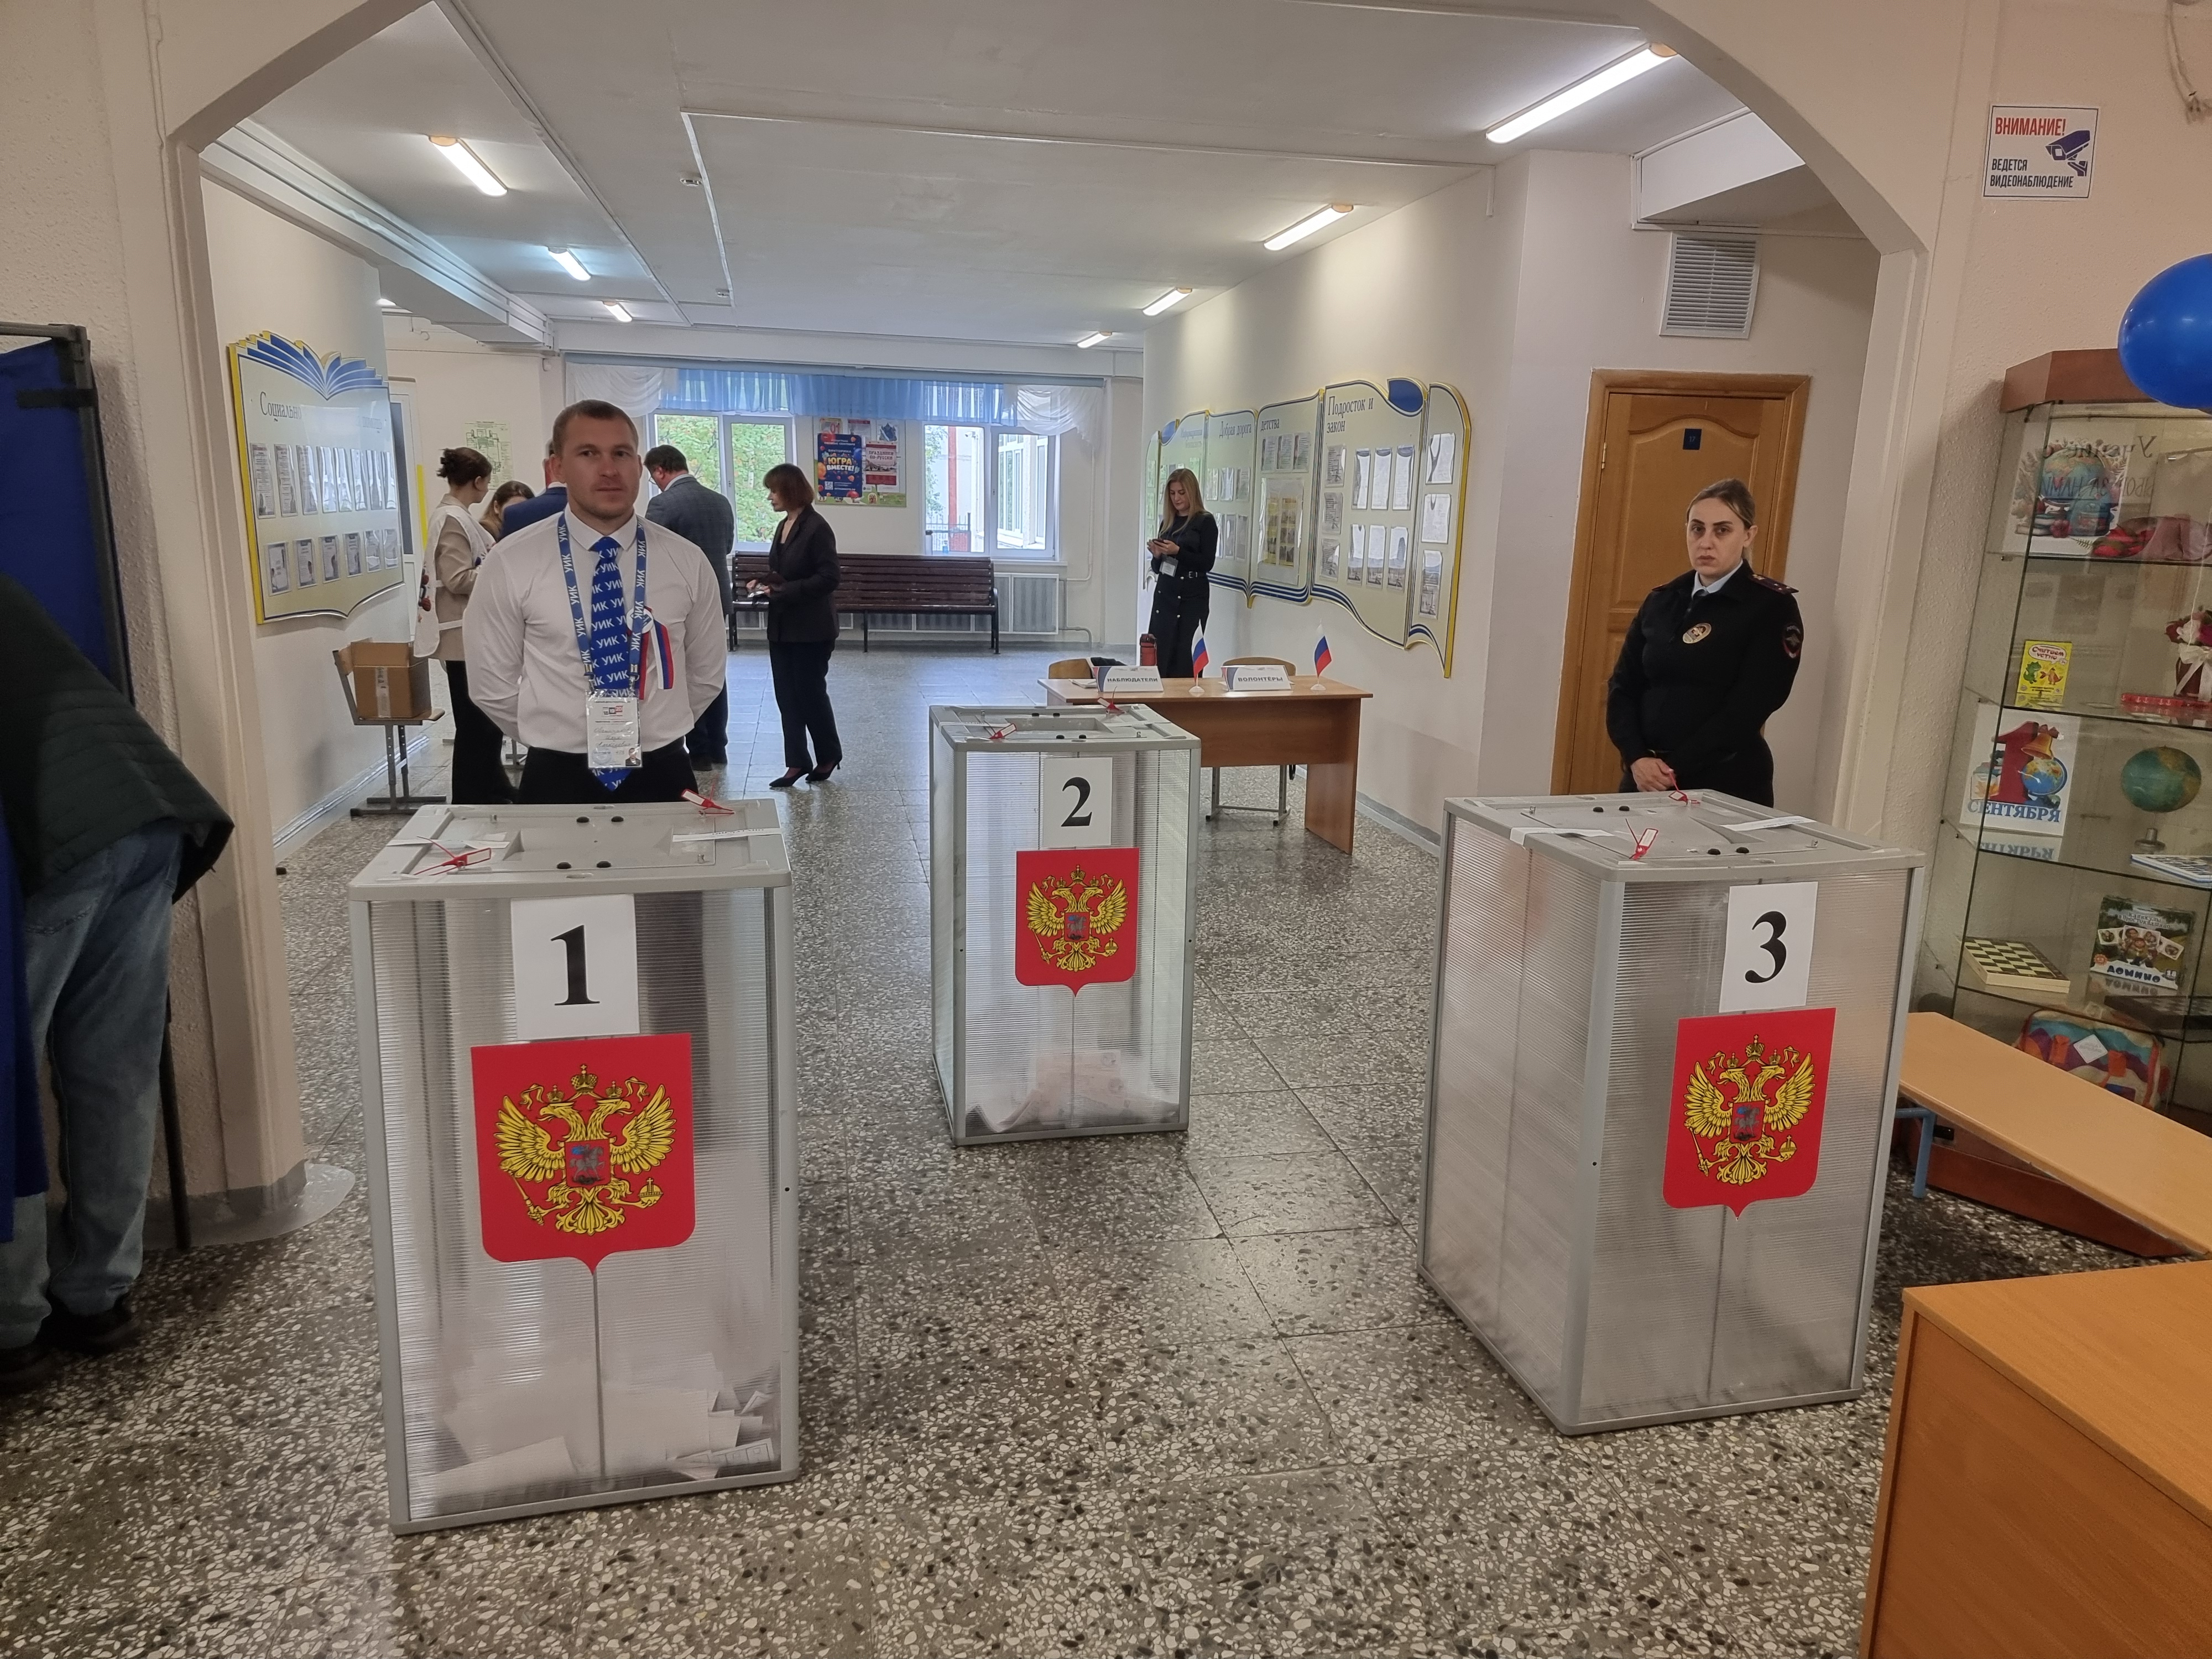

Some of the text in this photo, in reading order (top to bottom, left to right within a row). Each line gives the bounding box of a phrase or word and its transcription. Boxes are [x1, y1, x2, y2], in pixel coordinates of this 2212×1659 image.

[1995, 117, 2066, 135] ВНИМАНИЕ!
[1991, 159, 2028, 172] ВЕДЕТСЯ
[1990, 175, 2074, 189] ВИДЕОНАБЛЮДЕНИЕ
[1328, 396, 1374, 419] Подросток и
[1219, 421, 1235, 439] Добрая
[1236, 424, 1252, 438] дорога
[1260, 419, 1280, 431] детства
[1327, 420, 1345, 434] закон
[558, 524, 568, 542] УИК
[638, 540, 646, 558] УИК
[561, 554, 573, 573] УИК
[600, 562, 619, 573] УИК
[636, 570, 645, 588] УИК
[568, 585, 580, 605] УИК
[634, 601, 644, 620] УИК
[574, 617, 586, 637] УИК
[591, 618, 614, 632] УИК
[596, 636, 620, 649] УИК
[631, 632, 641, 651] УИК
[581, 649, 591, 664] ИК
[601, 653, 625, 665] УИК
[607, 670, 629, 683] УИК
[1060, 776, 1093, 827] 2
[1966, 800, 2062, 823] СЕНТЯБРЯ
[1744, 910, 1788, 984] 3
[550, 925, 601, 1006] 1
[2107, 965, 2161, 983] ДОМИНО
